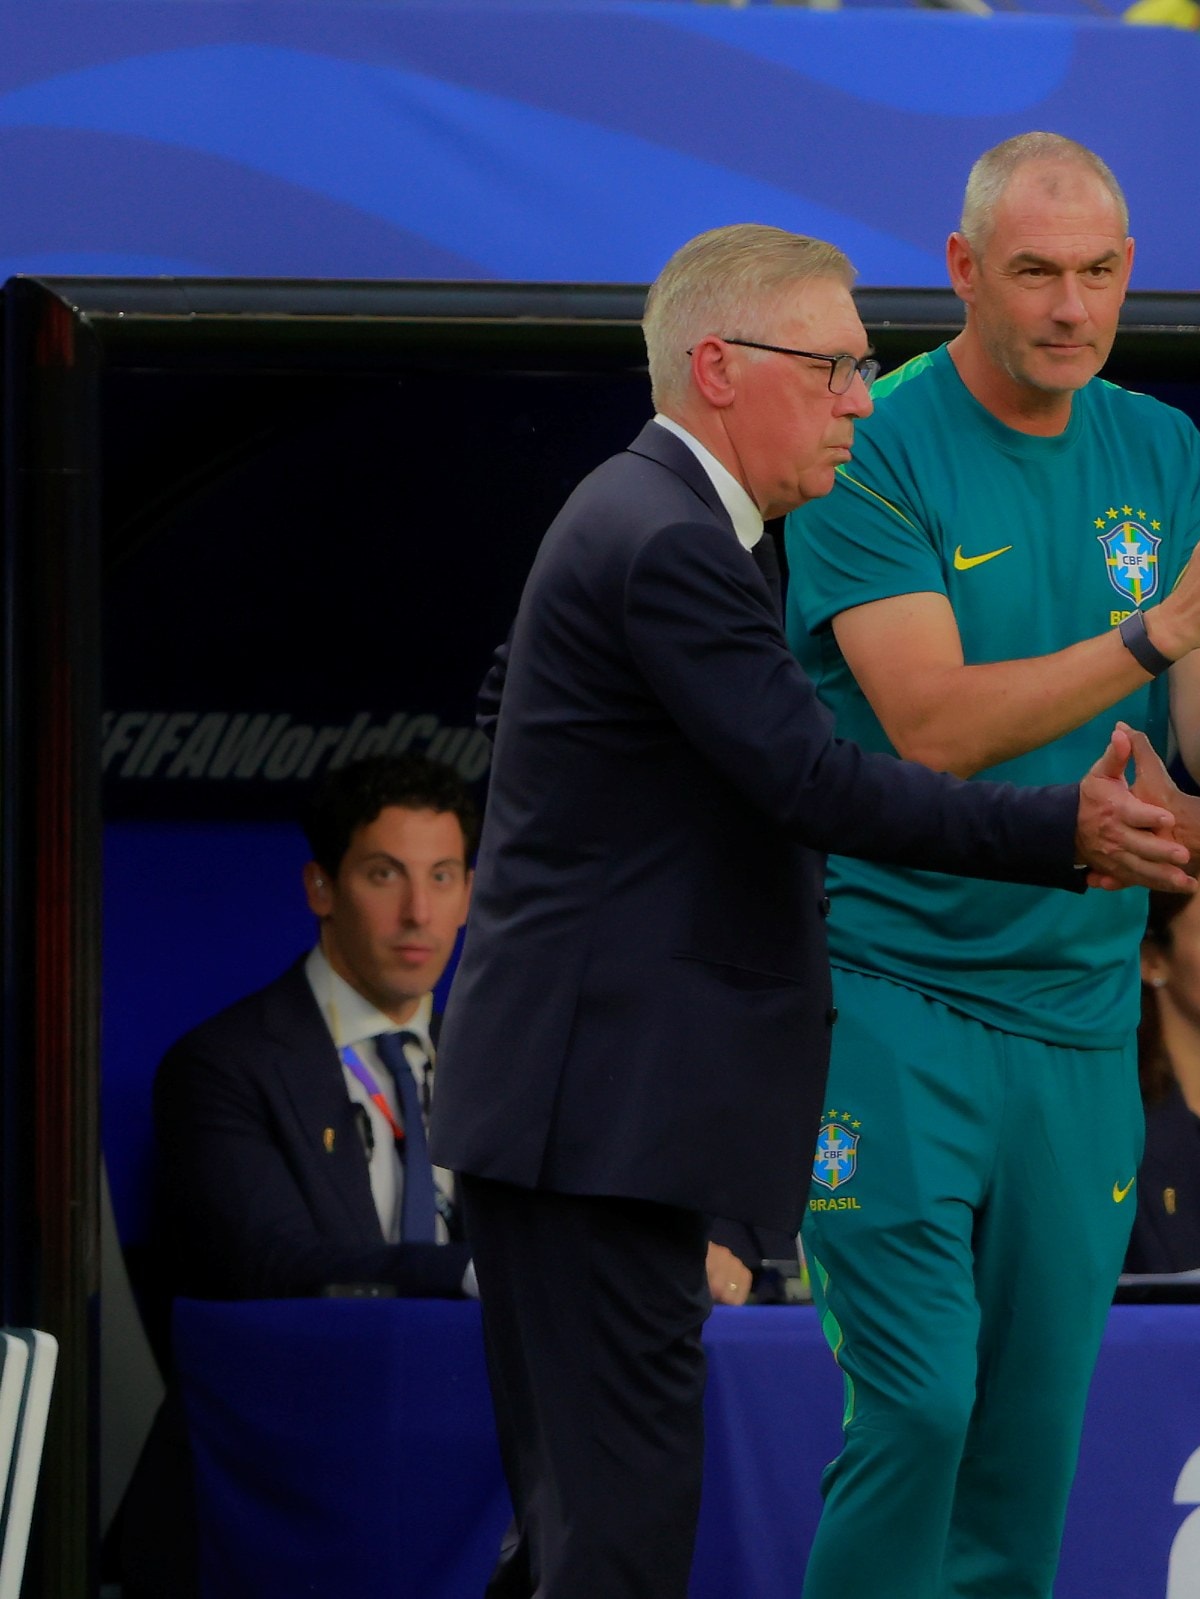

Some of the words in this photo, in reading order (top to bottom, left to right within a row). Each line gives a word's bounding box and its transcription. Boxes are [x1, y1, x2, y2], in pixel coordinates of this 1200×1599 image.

[1122, 555, 1143, 566] CBF
[823, 1150, 843, 1160] CBF
[809, 1197, 861, 1212] BRASIL
